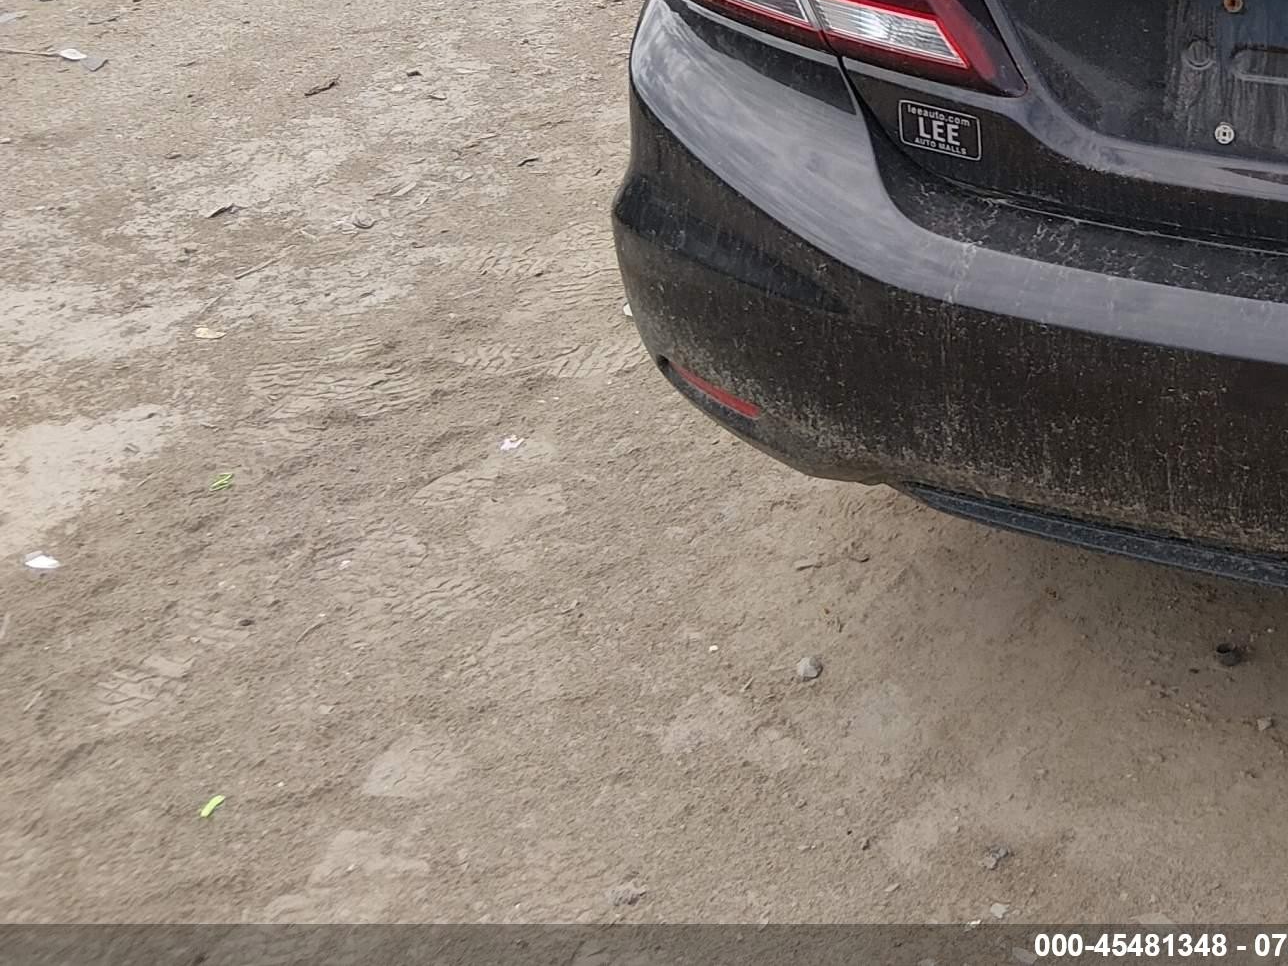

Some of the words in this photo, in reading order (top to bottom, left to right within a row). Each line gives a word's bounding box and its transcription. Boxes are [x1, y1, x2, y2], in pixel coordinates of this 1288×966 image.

[907, 104, 970, 127] leeauto.com
[918, 117, 960, 146] LEE
[914, 137, 937, 148] AUTO
[938, 142, 967, 155] MALLS
